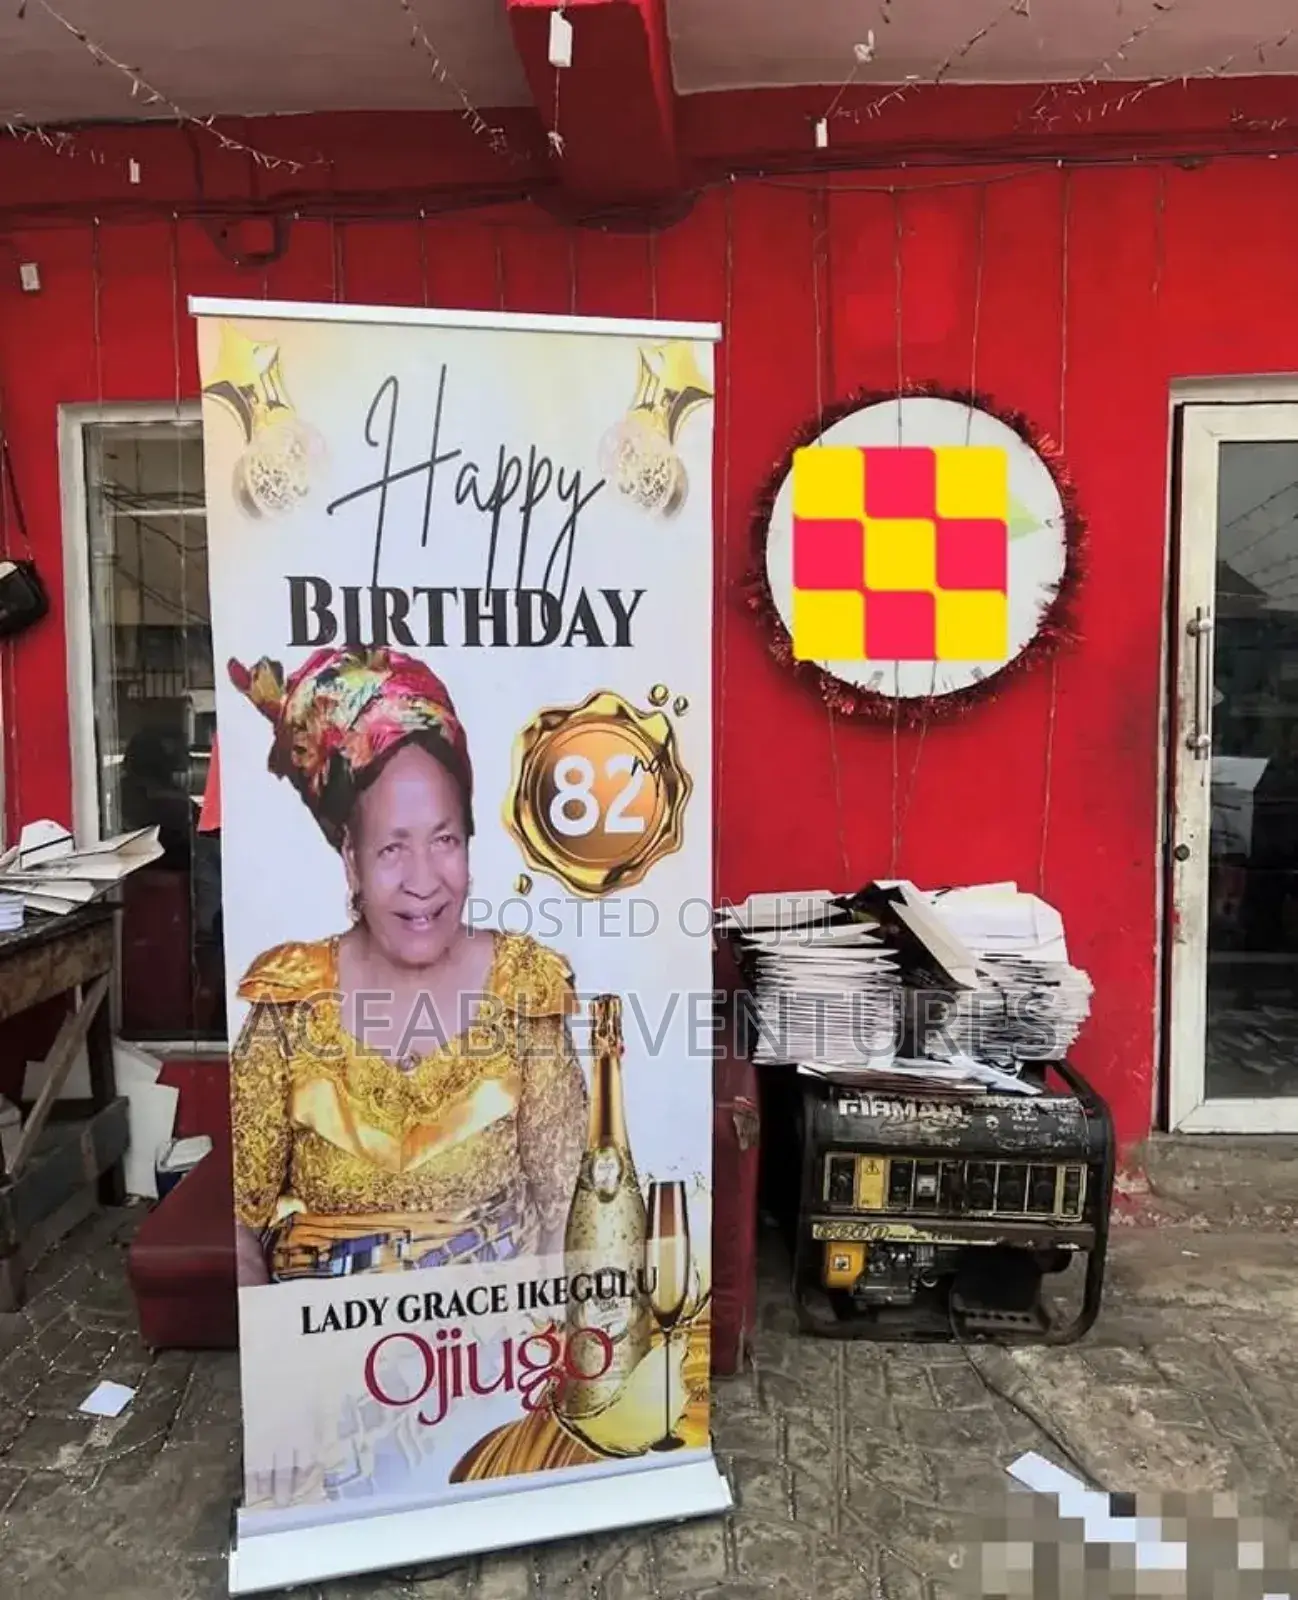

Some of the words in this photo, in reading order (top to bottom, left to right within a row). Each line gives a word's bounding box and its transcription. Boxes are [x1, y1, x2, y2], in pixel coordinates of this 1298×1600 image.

[327, 363, 606, 632] Happy
[284, 575, 648, 649] BIRTHDAY
[301, 1297, 389, 1335] LADY
[398, 1284, 508, 1323] GRACE
[517, 1267, 659, 1311] IKEGULU
[364, 1321, 614, 1426] Ojiugo
